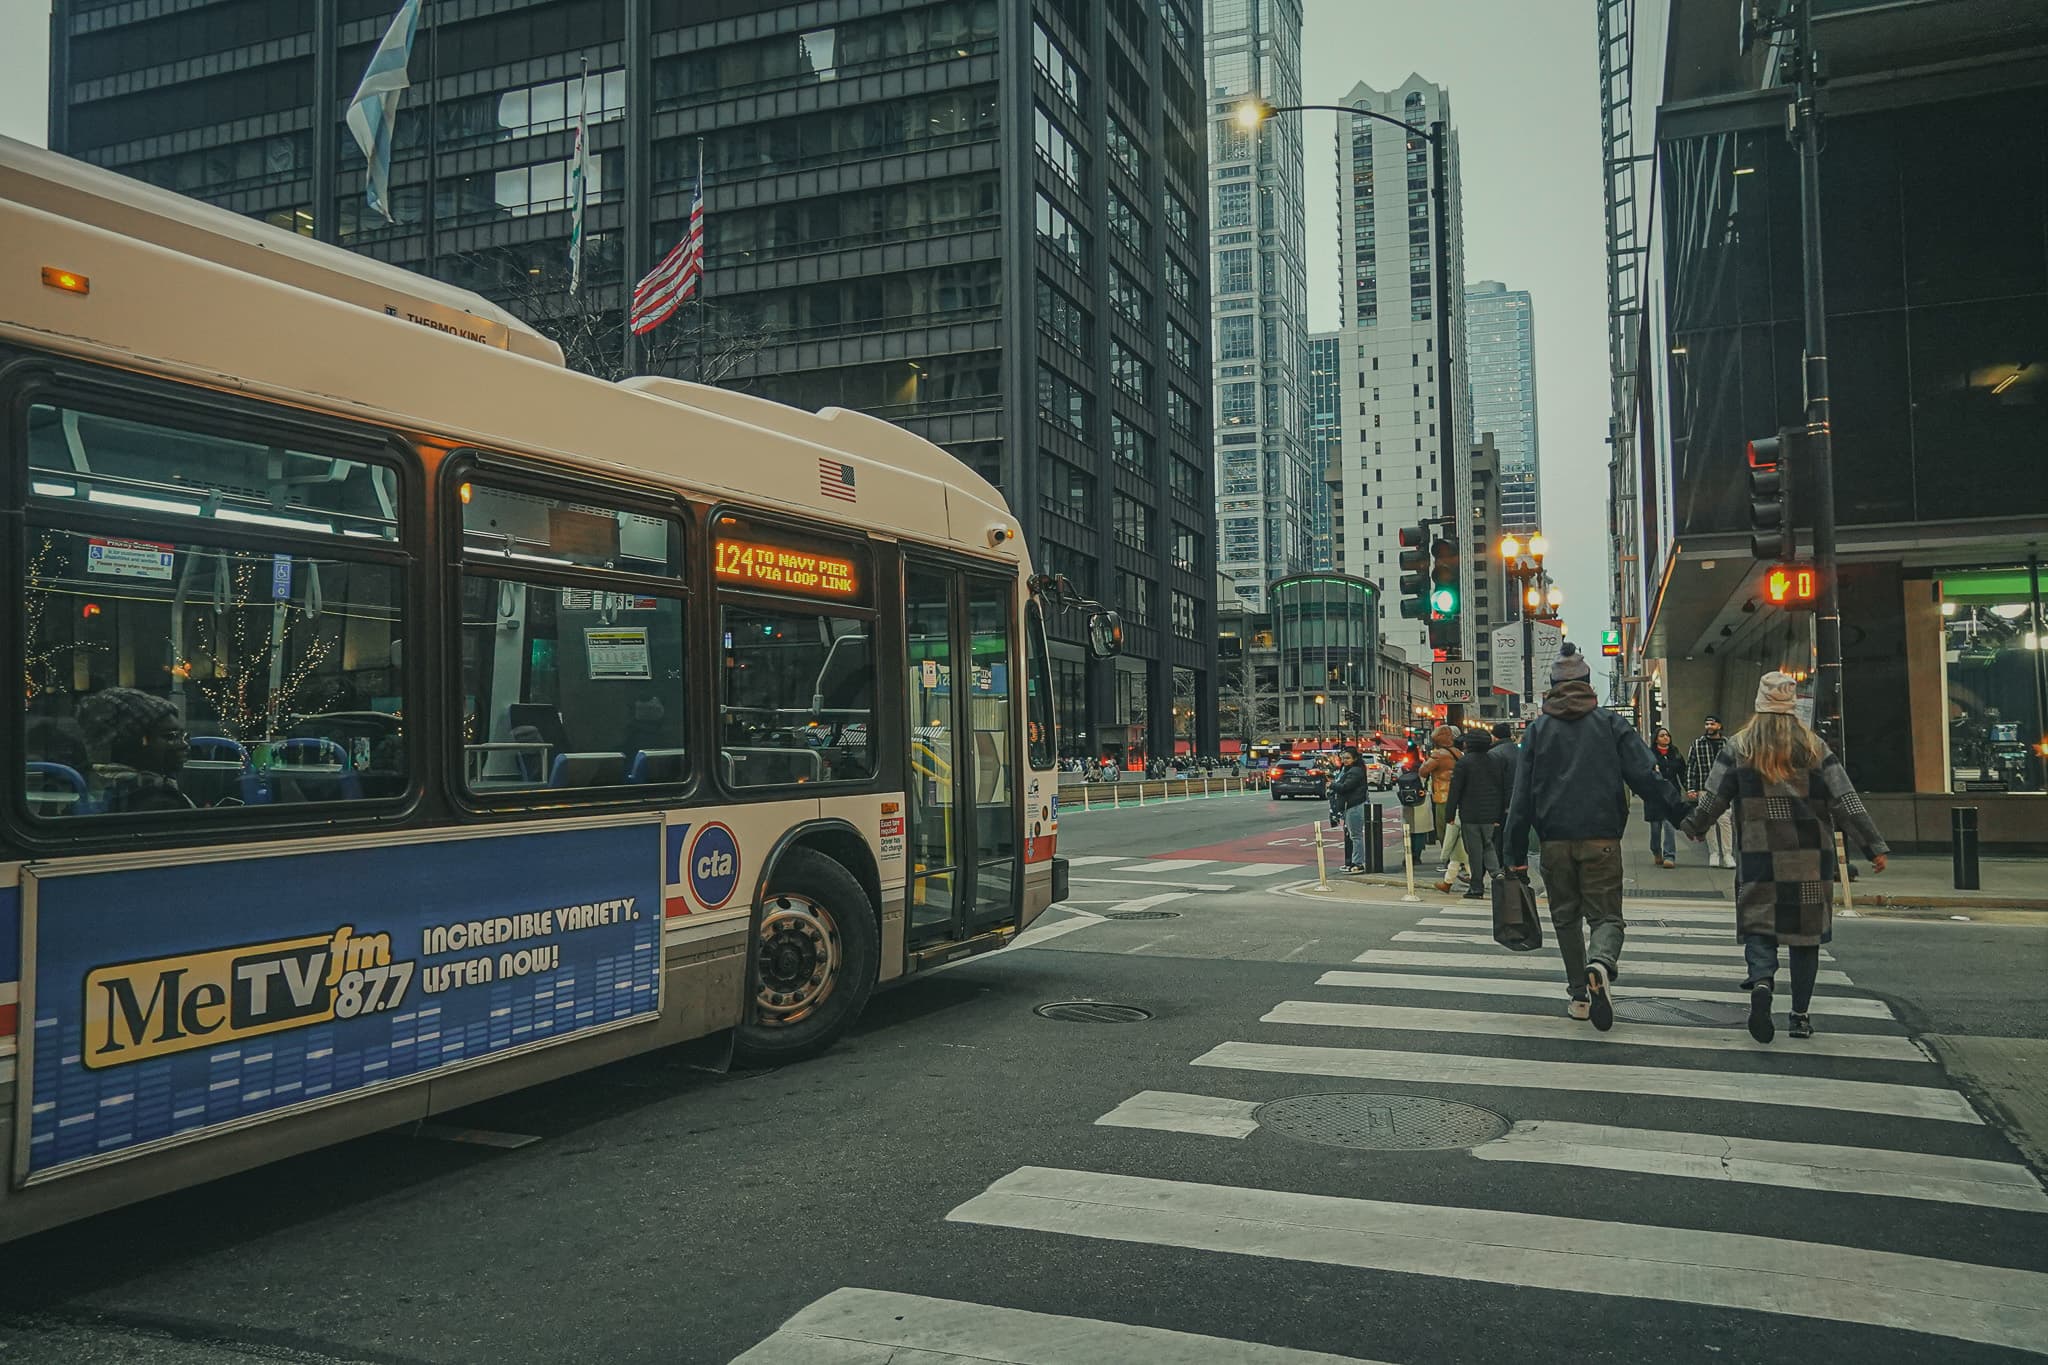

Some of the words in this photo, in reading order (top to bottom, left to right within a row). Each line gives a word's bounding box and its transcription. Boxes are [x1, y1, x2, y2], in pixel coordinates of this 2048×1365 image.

[406, 313, 458, 337] THERMO
[460, 329, 487, 344] KING
[716, 543, 754, 576] 124
[755, 549, 774, 564] TO
[778, 553, 815, 571] NAVY
[819, 560, 848, 577] PIER
[755, 564, 781, 581] VIA
[785, 569, 818, 586] LOOP
[822, 575, 852, 592] LINK
[1441, 678, 1466, 687] TURN
[1445, 666, 1461, 675] NO
[1436, 690, 1449, 699] ON
[698, 850, 732, 879] cta
[424, 911, 552, 955] INCREDIBLE
[555, 898, 639, 932] VARIETY.
[326, 927, 391, 986] fm
[423, 957, 493, 993] LISTEN
[499, 945, 559, 979] NOW!
[335, 962, 414, 1019] 87.7
